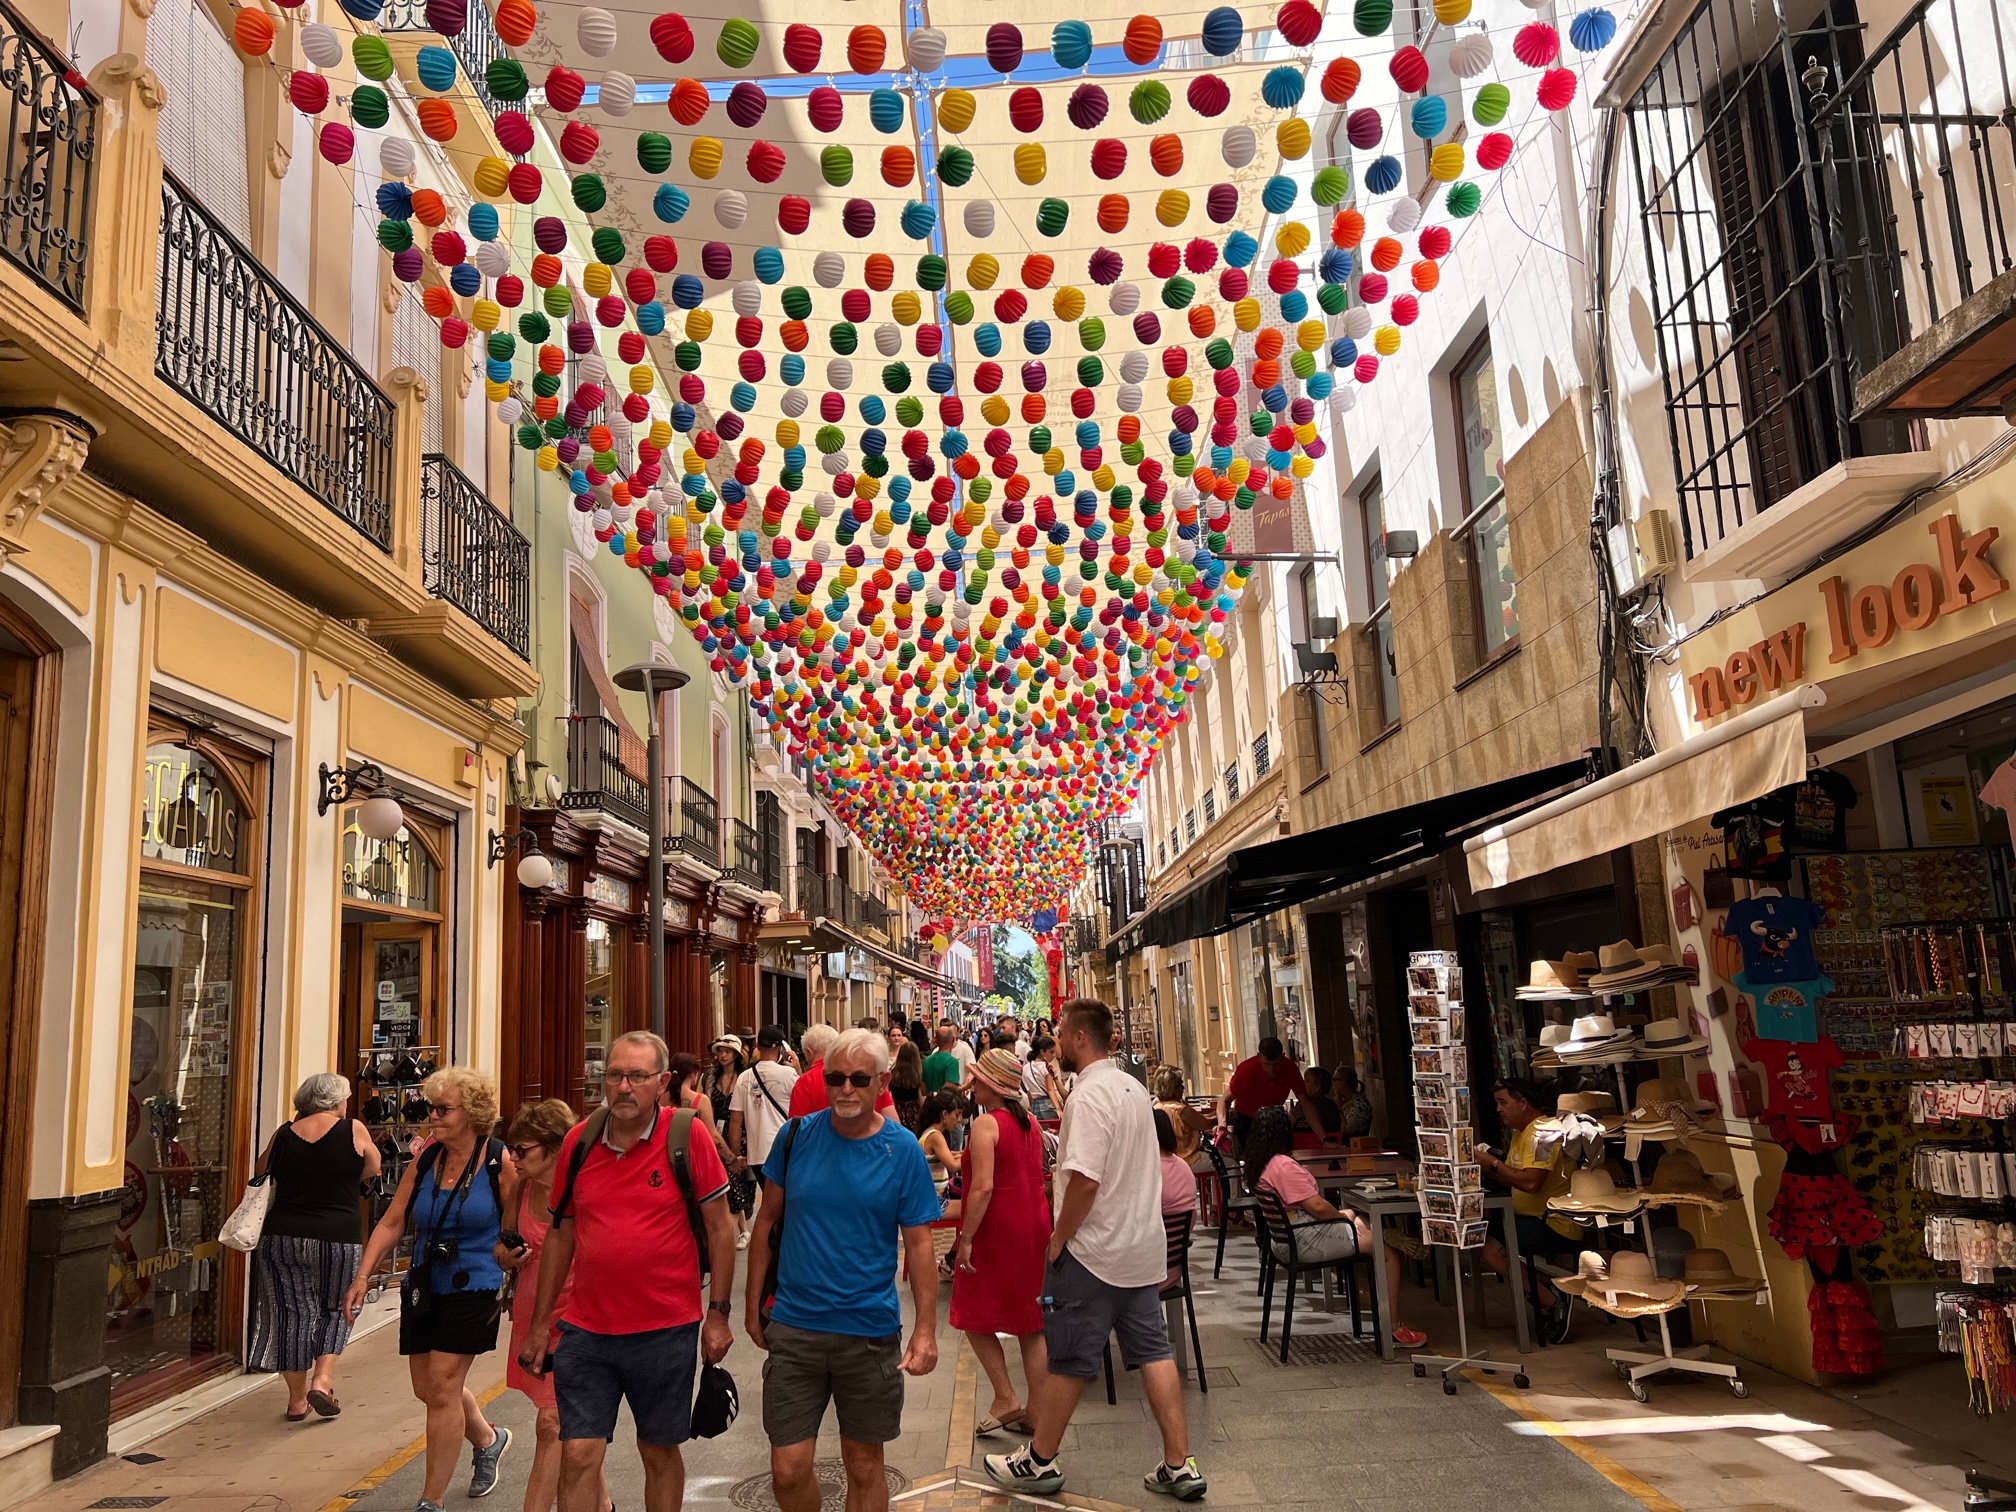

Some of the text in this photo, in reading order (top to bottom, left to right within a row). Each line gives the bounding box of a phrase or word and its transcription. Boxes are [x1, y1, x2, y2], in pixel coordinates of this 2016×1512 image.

[1255, 507, 1290, 528] Tapas
[1689, 514, 2010, 721] new look
[1410, 953, 1443, 964] GOEZ
